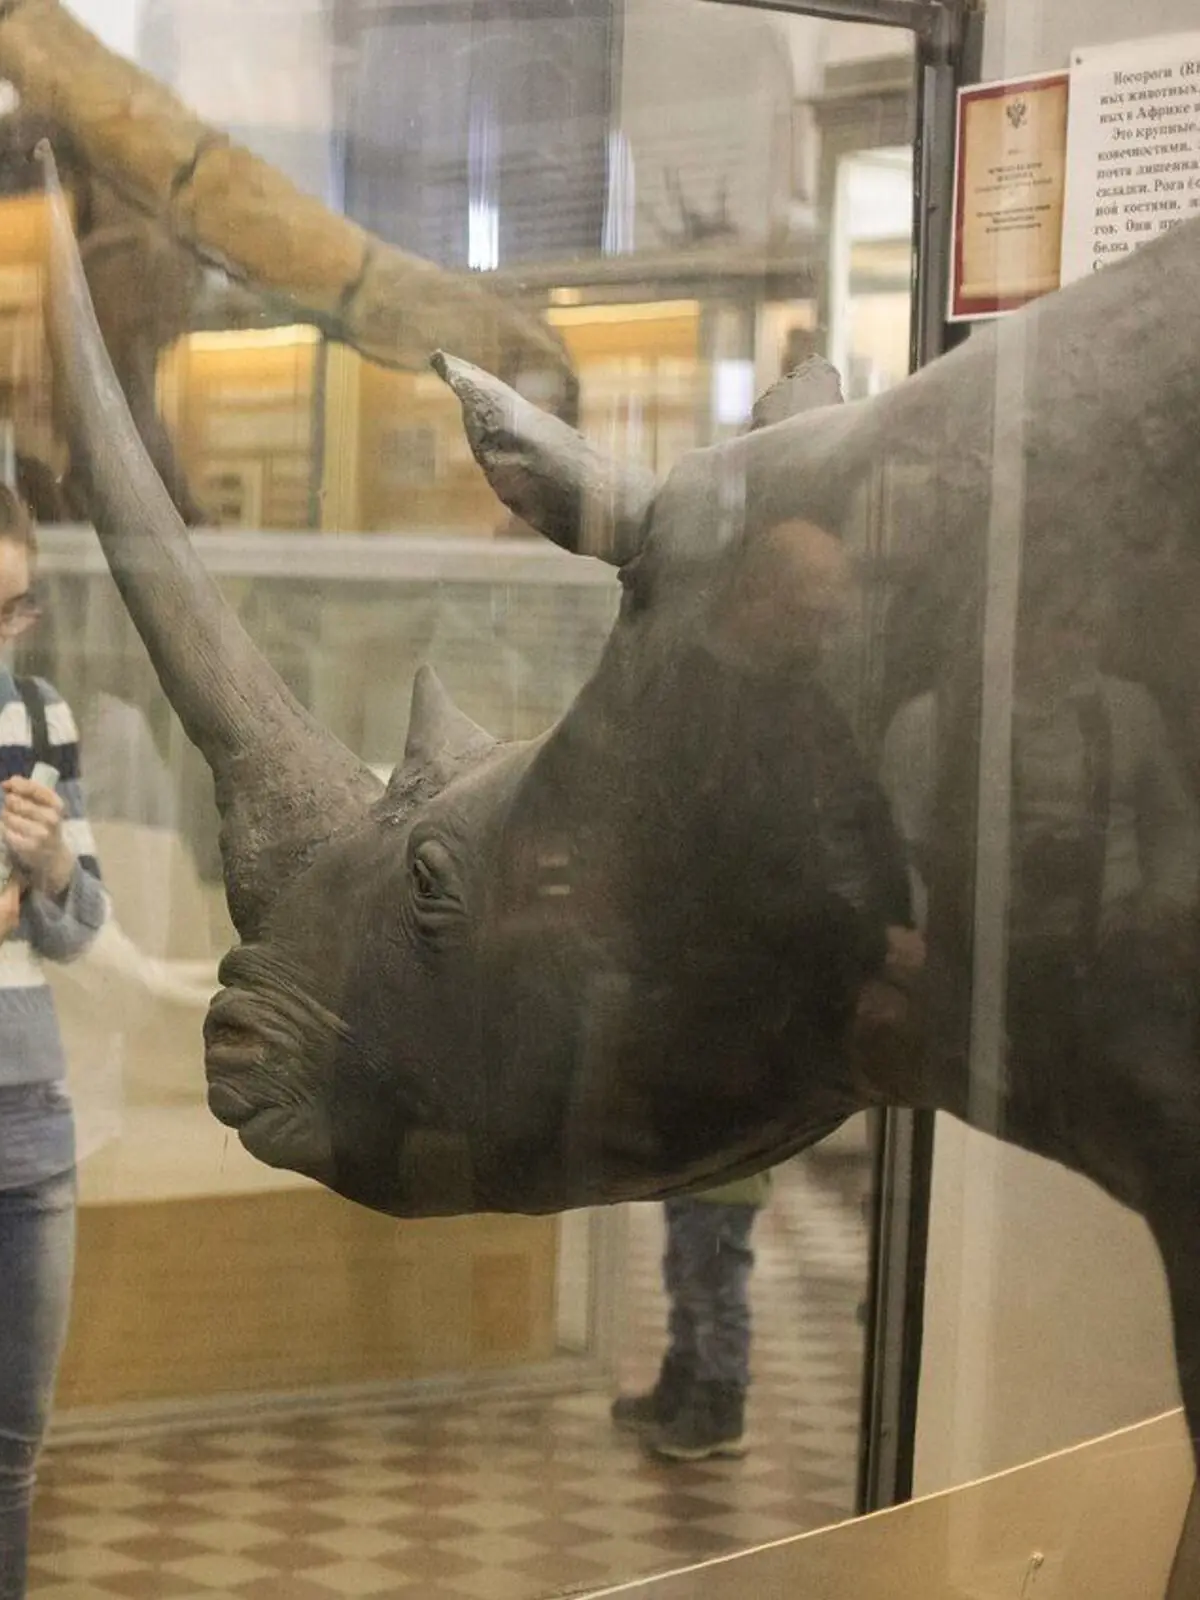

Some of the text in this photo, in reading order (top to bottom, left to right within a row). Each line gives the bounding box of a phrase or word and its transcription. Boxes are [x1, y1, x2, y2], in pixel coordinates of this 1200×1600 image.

[1114, 68, 1172, 85] Носороги
[1100, 93, 1124, 105] ных
[1100, 112, 1124, 124] ных
[1136, 103, 1191, 121] Африке
[1112, 126, 1133, 141] Это
[1154, 178, 1185, 193] Рога
[1095, 200, 1118, 217] ной
[1126, 218, 1153, 233] Они
